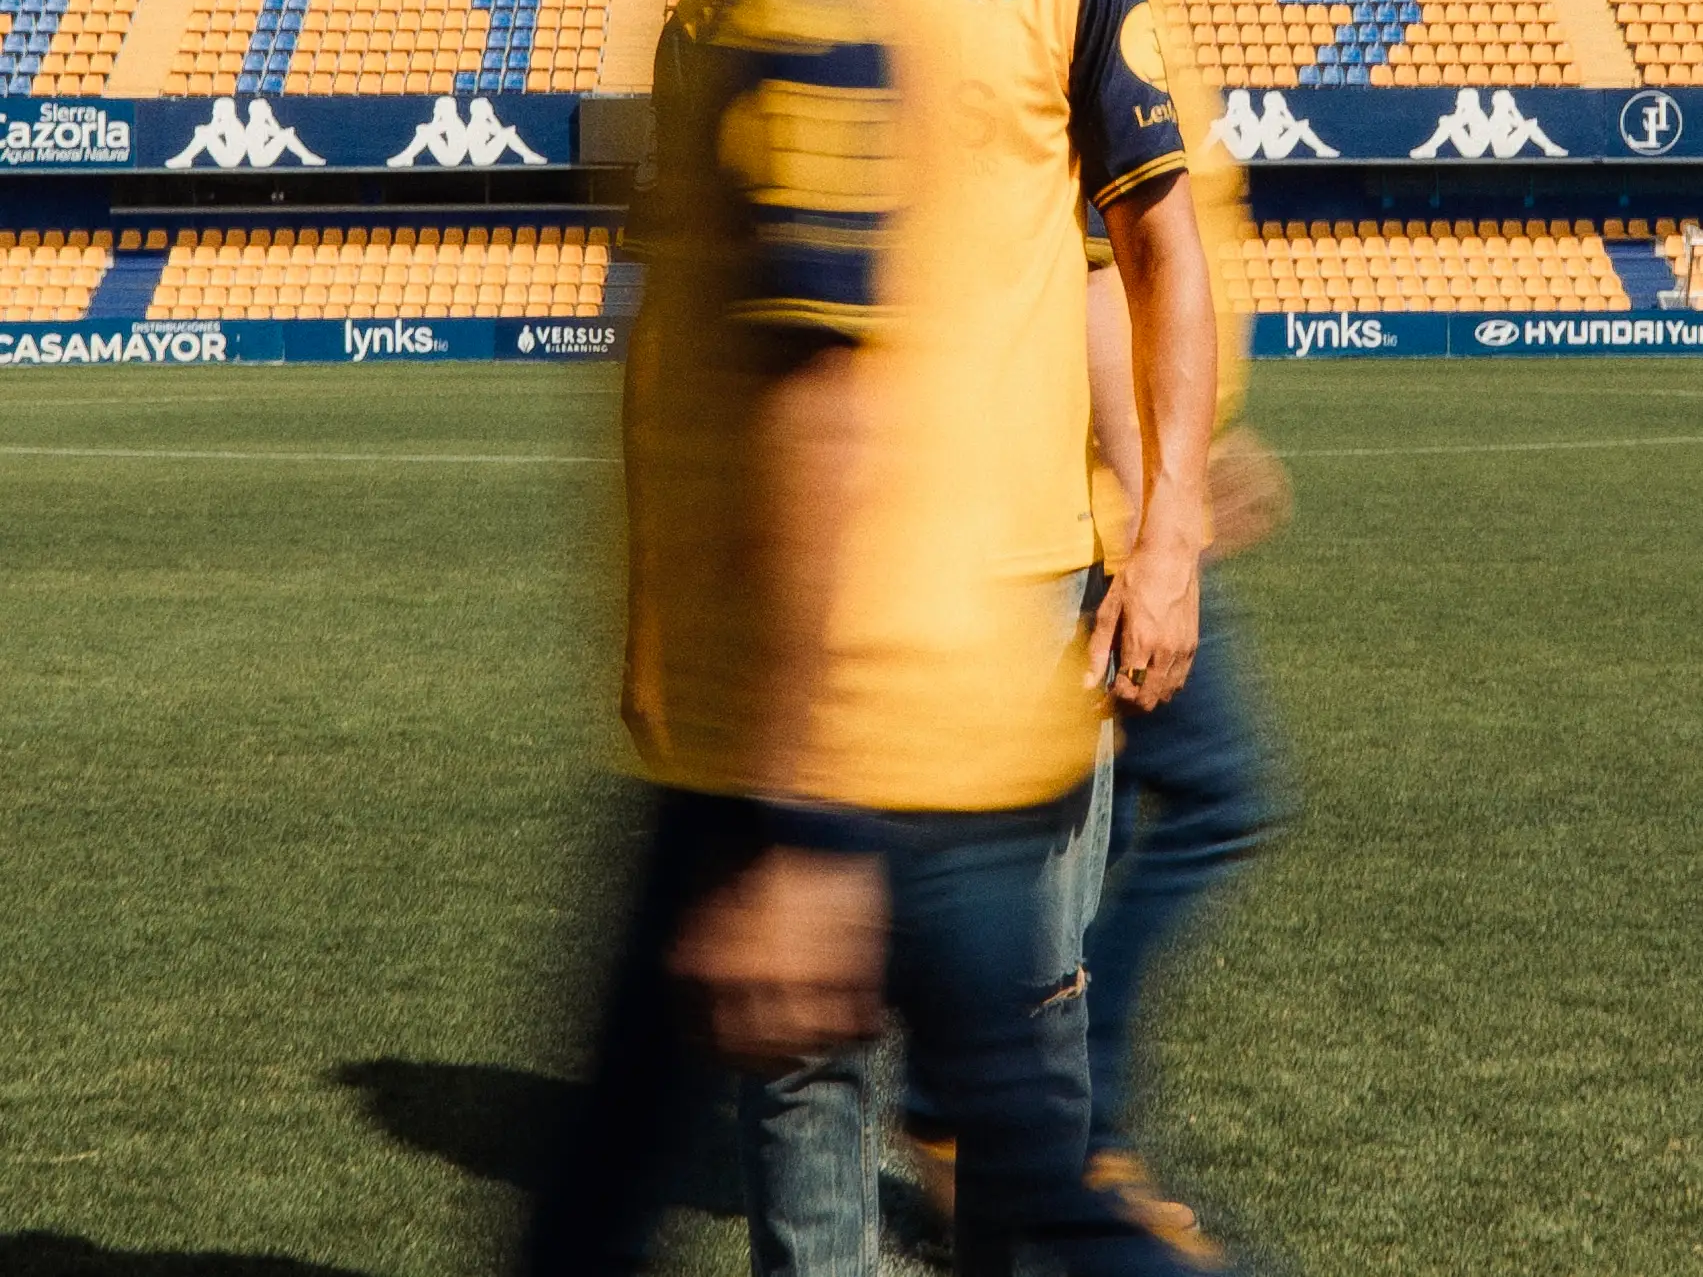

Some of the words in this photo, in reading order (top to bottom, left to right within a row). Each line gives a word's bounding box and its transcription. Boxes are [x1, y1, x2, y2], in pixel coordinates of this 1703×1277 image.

[40, 102, 97, 122] Sierra
[0, 110, 130, 149] azorla
[0, 147, 35, 165] Agua
[37, 147, 83, 162] Mineral
[84, 147, 130, 162] Natural
[345, 319, 433, 362] lynks
[536, 325, 616, 344] VERSUS
[1287, 312, 1382, 357] lynks
[1524, 319, 1664, 345] HYUNDAI
